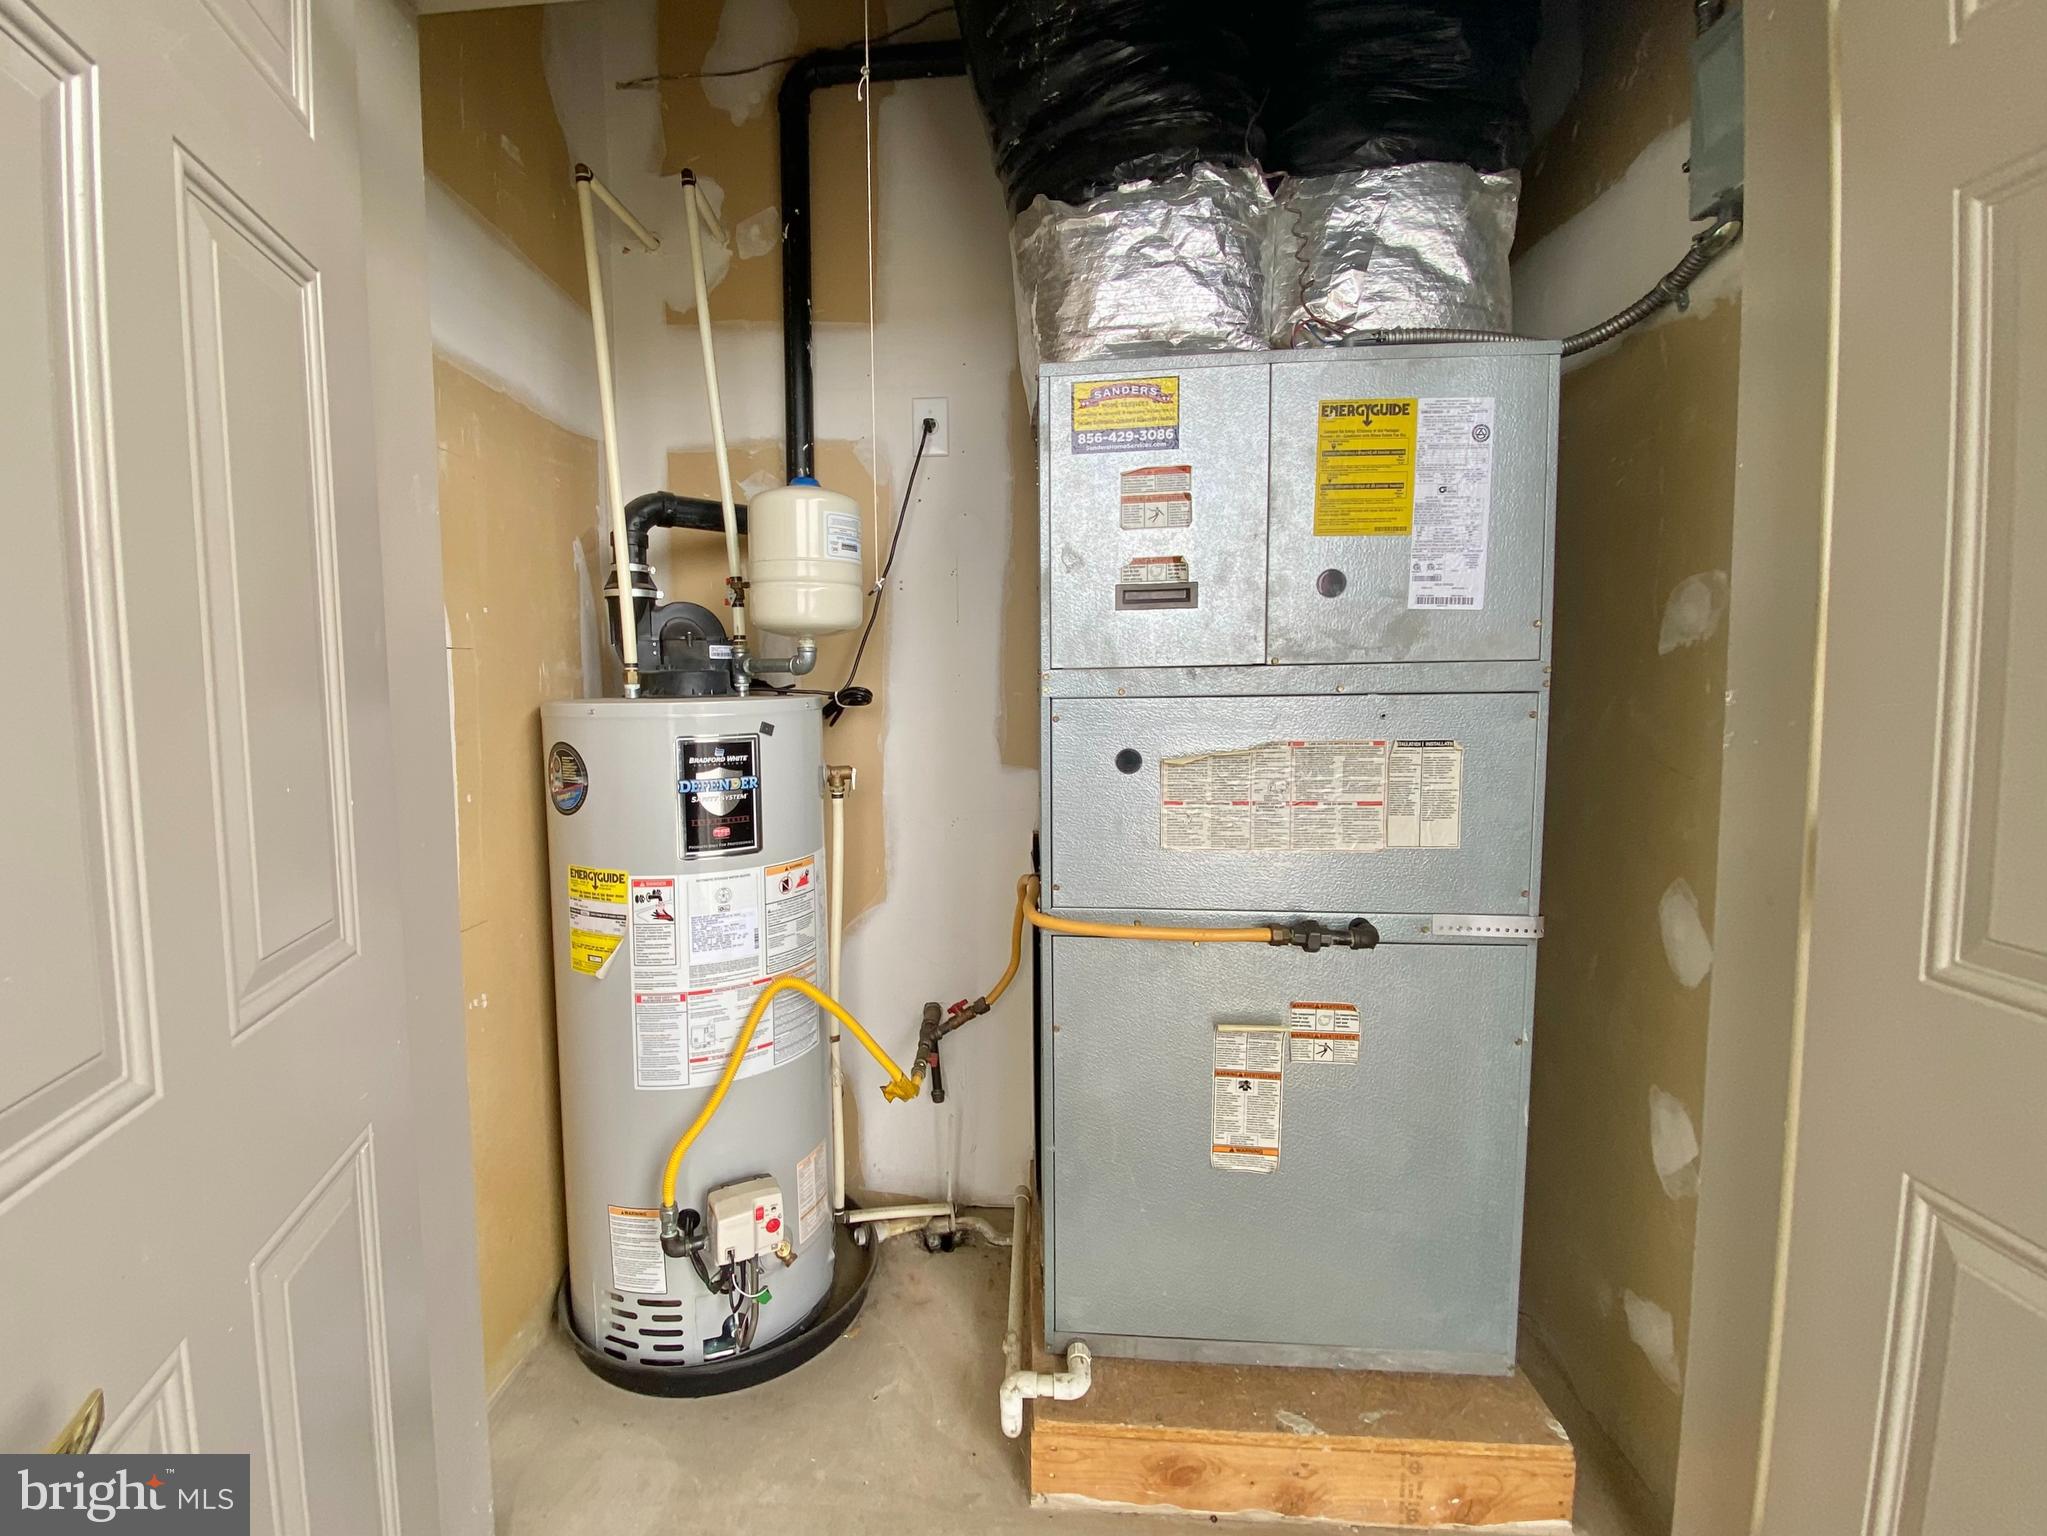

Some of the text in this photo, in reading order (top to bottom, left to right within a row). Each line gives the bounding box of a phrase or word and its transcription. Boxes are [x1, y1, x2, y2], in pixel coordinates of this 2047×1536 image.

[1094, 385, 1158, 399] SANDERS
[1321, 403, 1411, 418] ENERGYGUIDE
[1077, 428, 1174, 445] 856-429-3086
[689, 756, 726, 764] BRADFORD
[678, 776, 759, 794] DEFENDER
[570, 868, 625, 884] ENERGYGUIDE
